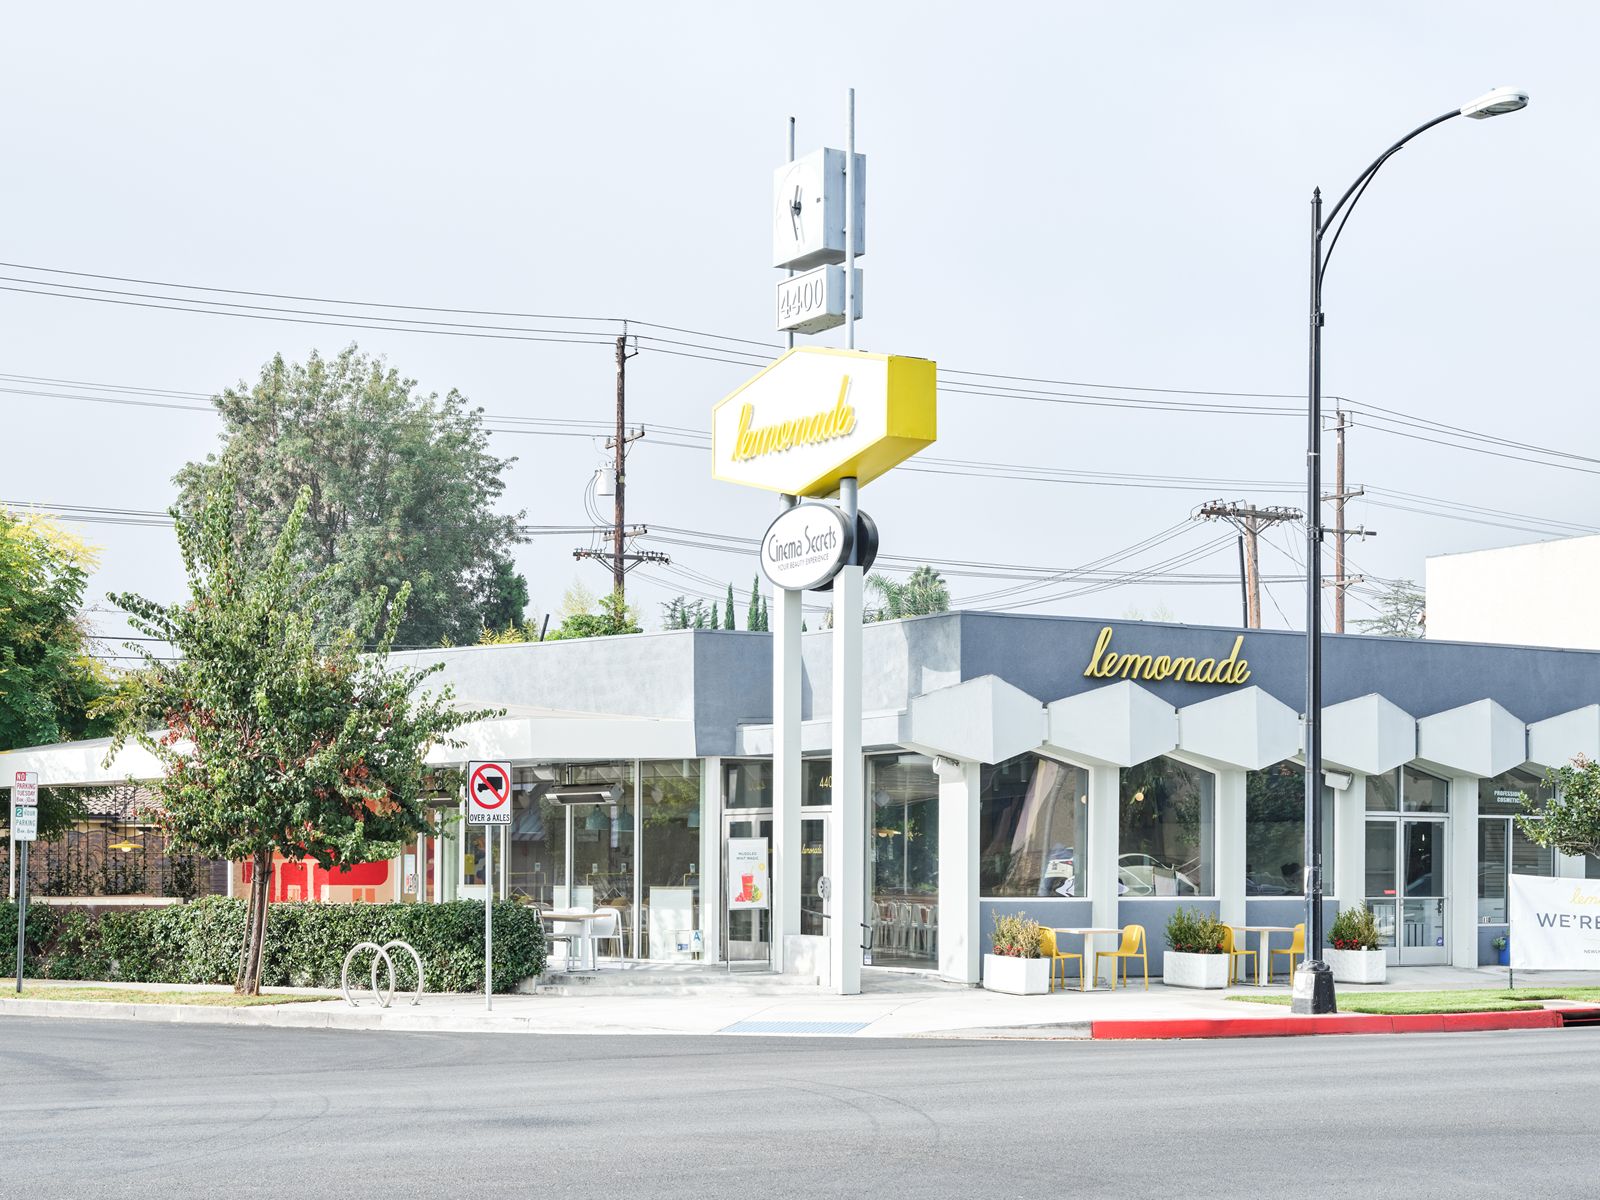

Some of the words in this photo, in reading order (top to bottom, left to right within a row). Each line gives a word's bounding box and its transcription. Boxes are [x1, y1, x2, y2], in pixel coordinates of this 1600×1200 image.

[780, 278, 824, 319] 4400
[731, 374, 856, 462] lemonade
[768, 534, 803, 562] Cinema
[804, 525, 837, 554] Secrets
[778, 563, 789, 571] YOUR
[790, 559, 805, 568] BEAUTY
[806, 553, 829, 565] EXPERIENCE
[1084, 626, 1251, 684] lemonade
[17, 773, 26, 781] NO
[820, 776, 832, 788] 440
[17, 808, 22, 817] 2
[16, 819, 36, 827] PARKING
[1570, 887, 1600, 905] lem
[694, 931, 701, 941] A
